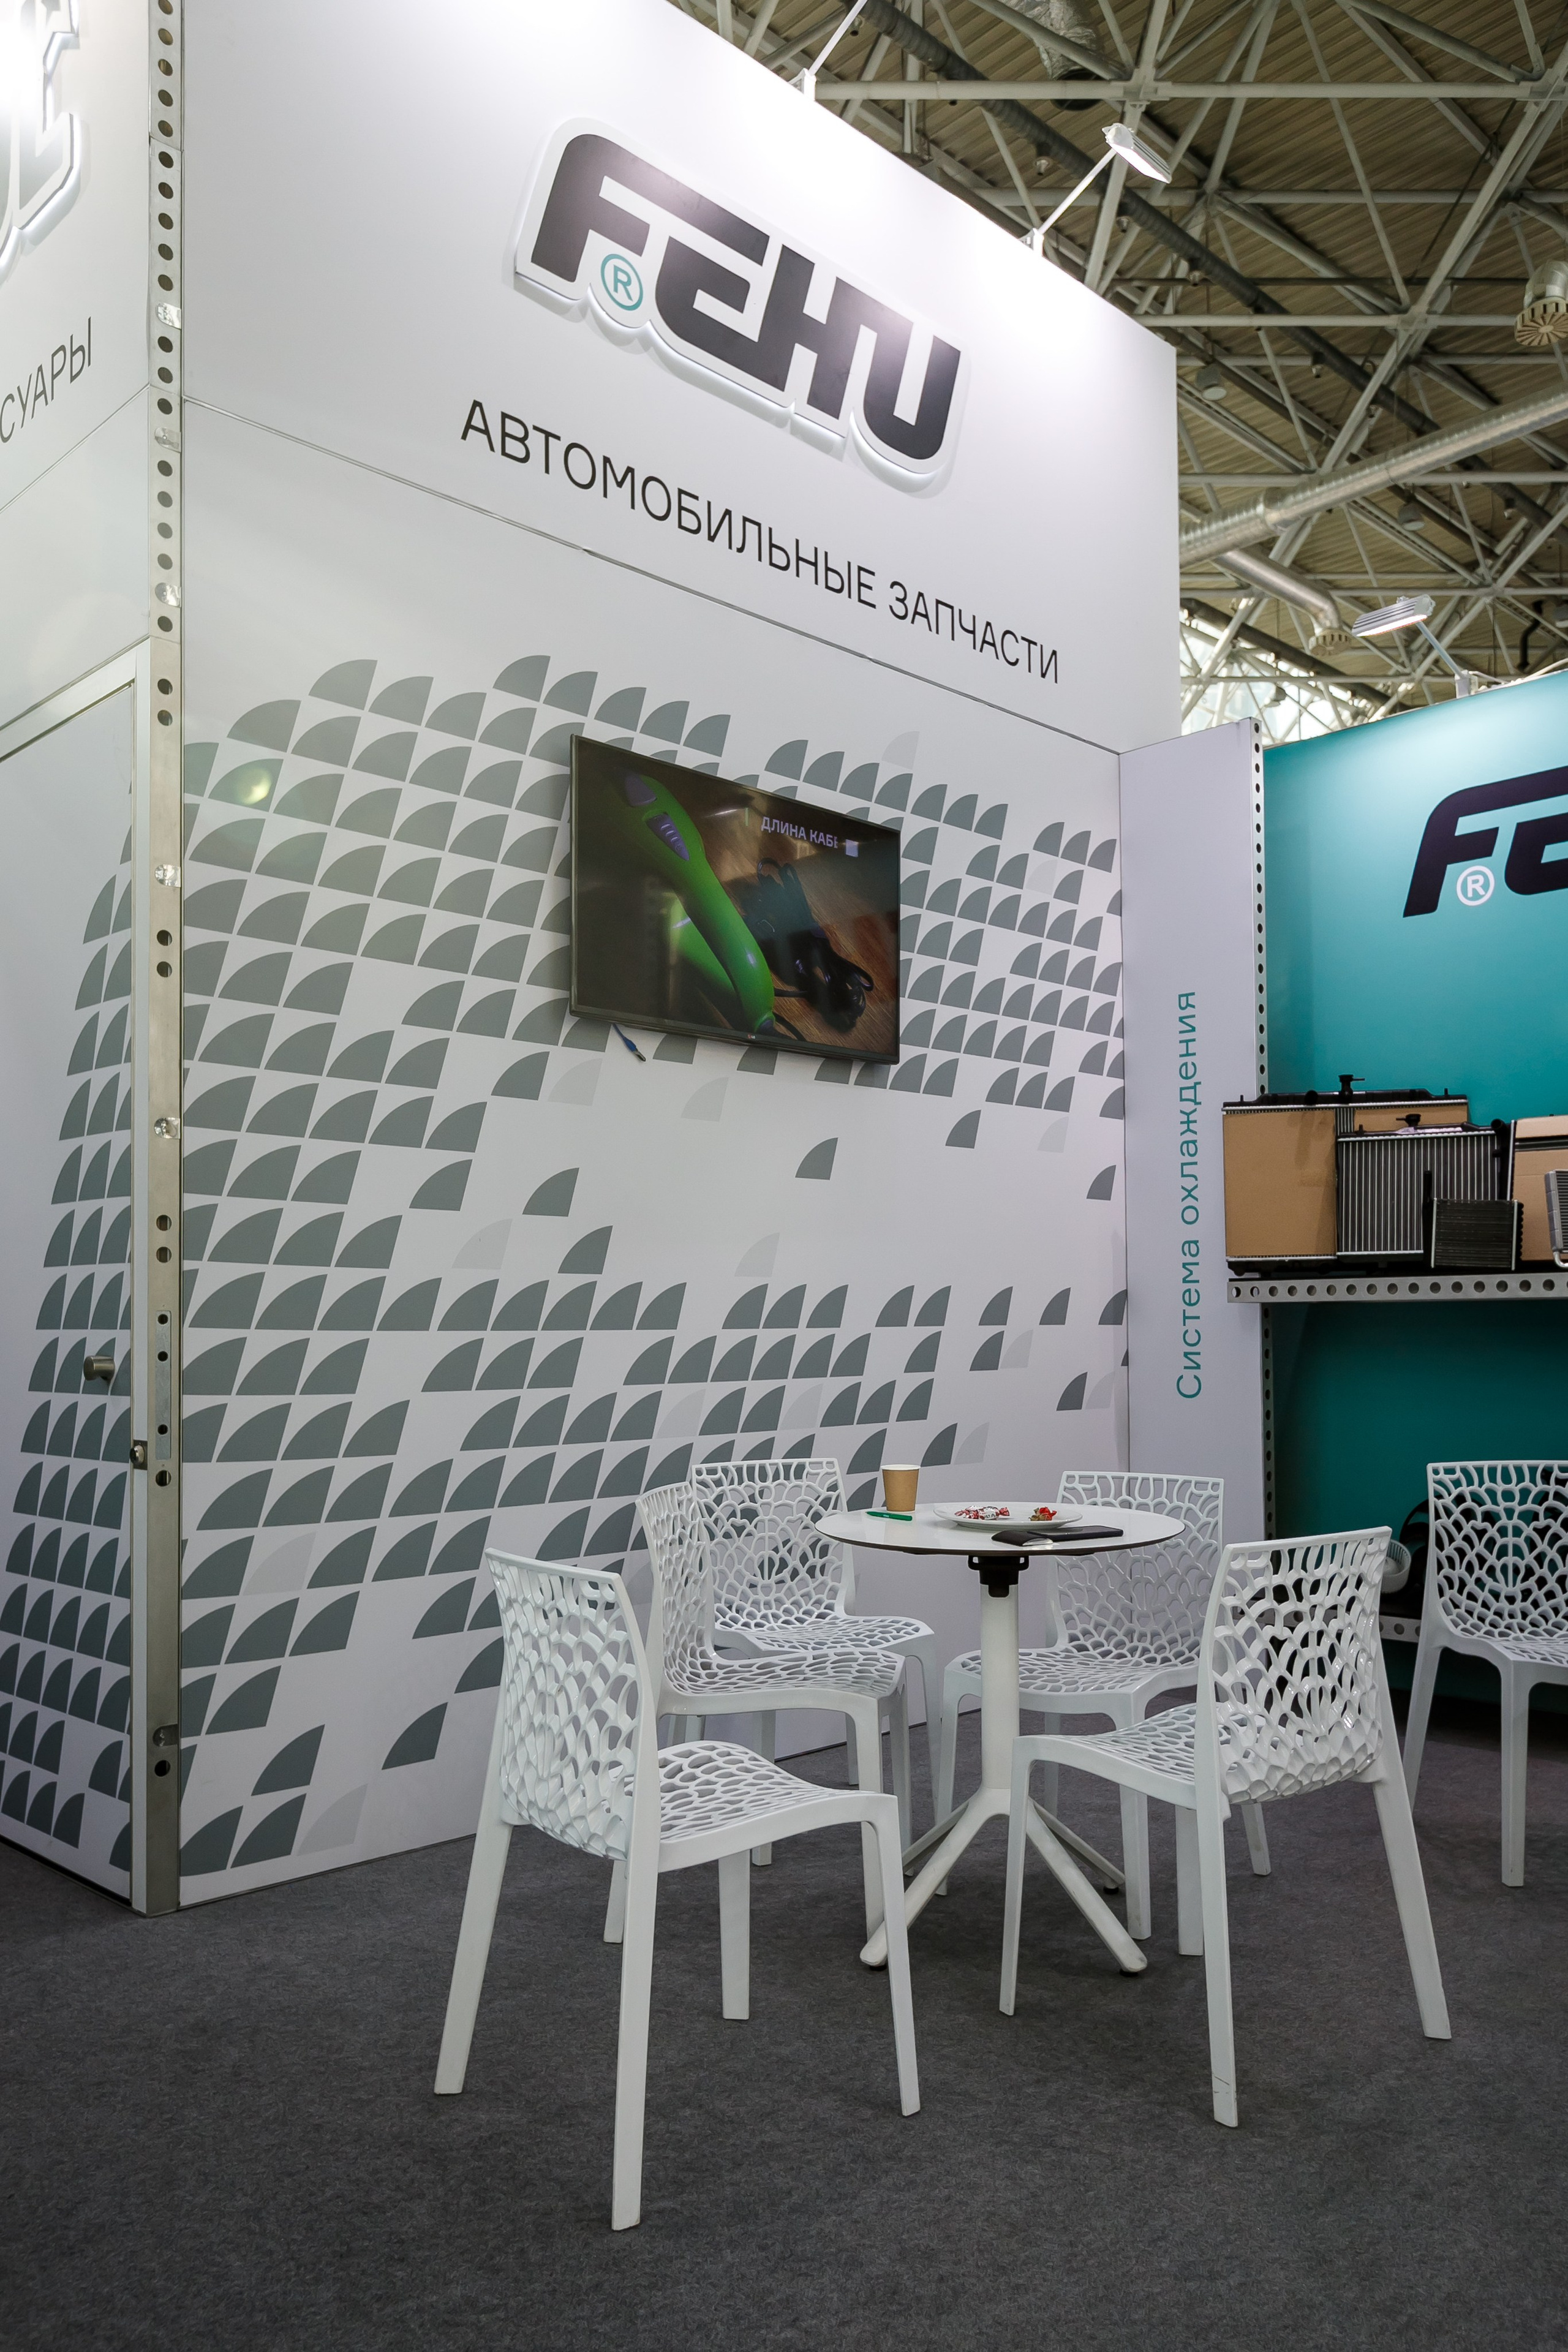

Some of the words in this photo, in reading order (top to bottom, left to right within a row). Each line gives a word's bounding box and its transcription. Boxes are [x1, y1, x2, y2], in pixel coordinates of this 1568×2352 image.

[0, 316, 91, 443] СУАРЫ
[530, 134, 961, 460] FEHU
[461, 399, 877, 609] АВТОМОБИЛЬНЫЕ
[889, 581, 1058, 684] ЗАПЧАСТИ
[761, 816, 807, 840] ДЛИНА
[1178, 991, 1202, 1226] охлаждения
[1176, 1239, 1202, 1399] Система
